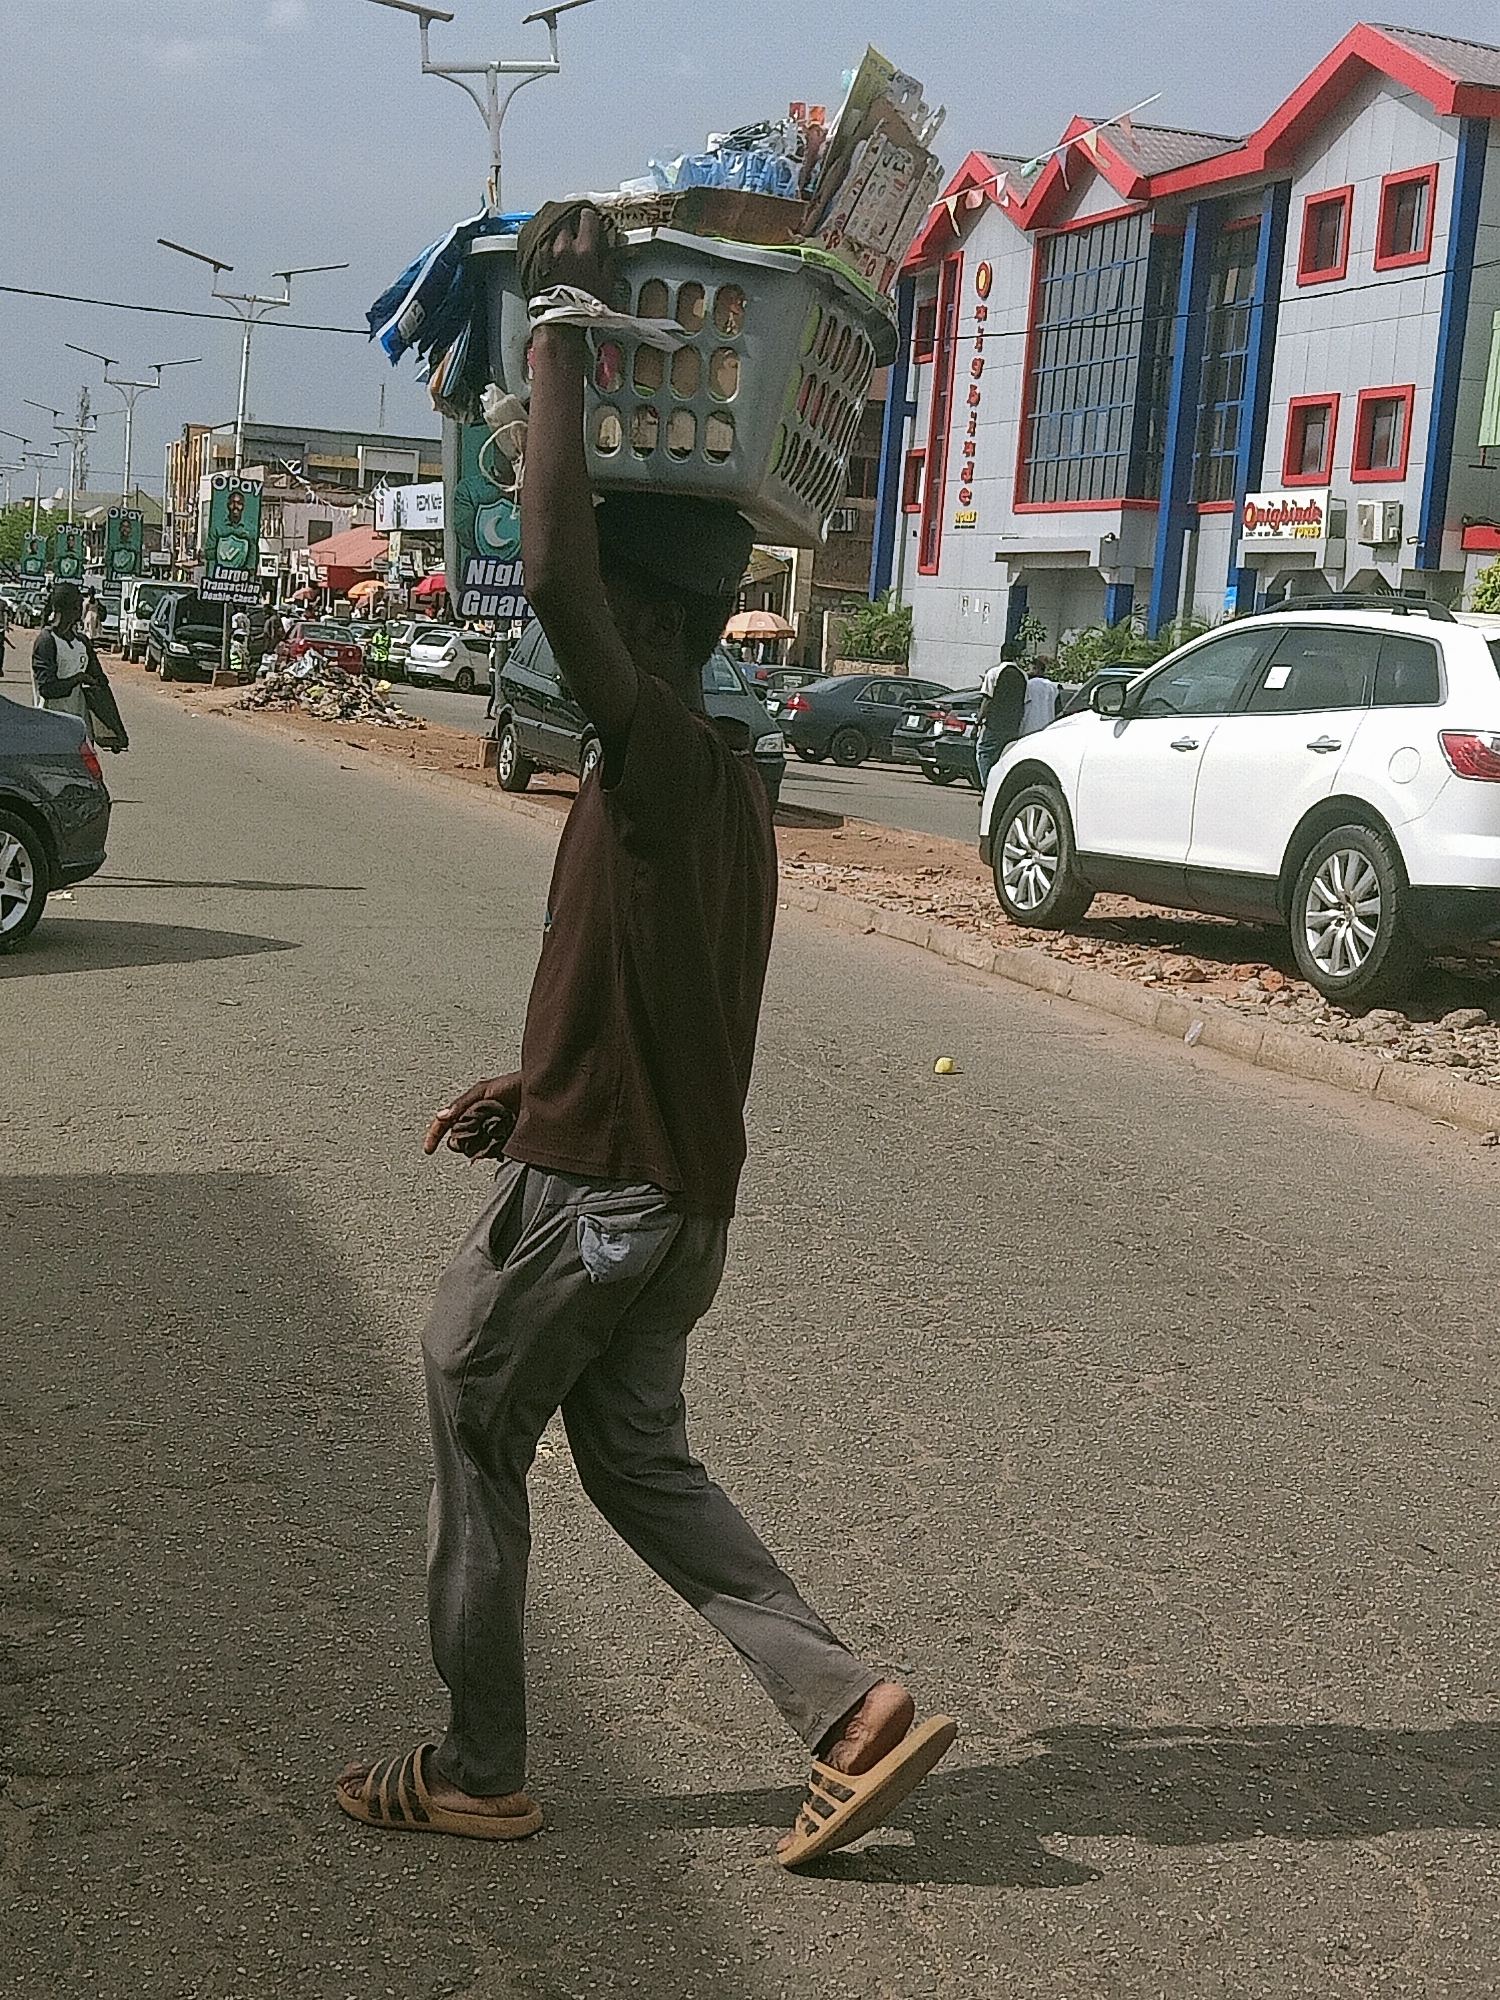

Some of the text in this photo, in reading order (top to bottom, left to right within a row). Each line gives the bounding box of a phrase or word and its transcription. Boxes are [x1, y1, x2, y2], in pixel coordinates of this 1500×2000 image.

[212, 474, 264, 496] OPay
[108, 507, 143, 522] OPay
[1243, 498, 1323, 531] Onigbinde
[215, 566, 249, 583] Large
[465, 559, 524, 587] Nigh
[202, 578, 260, 595] Transaction
